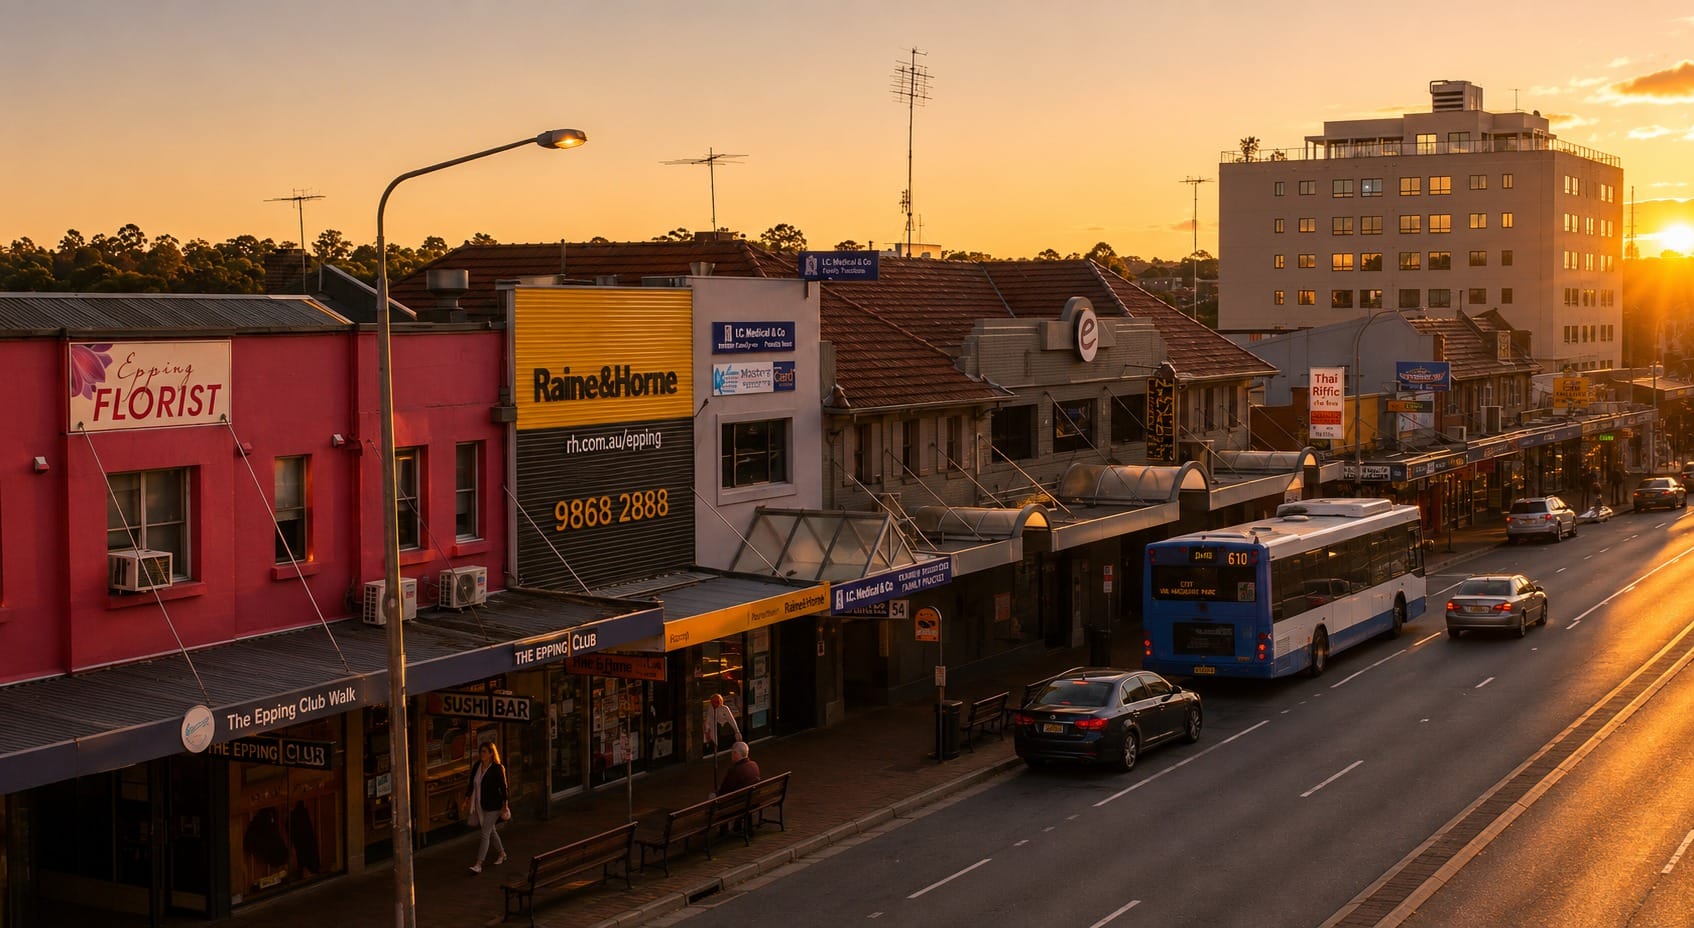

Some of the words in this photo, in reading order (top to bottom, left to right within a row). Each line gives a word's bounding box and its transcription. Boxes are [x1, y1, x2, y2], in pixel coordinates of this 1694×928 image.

[777, 327, 786, 337] Co
[1081, 318, 1097, 350] e
[117, 351, 194, 403] Epping
[533, 364, 678, 403] Raine&Horne
[1314, 373, 1338, 384] Thai
[93, 383, 222, 422] FLORIST
[566, 428, 662, 454] rh.com.au/epping
[554, 495, 612, 532] 9868
[618, 488, 669, 523] 2888
[1228, 552, 1248, 565] 610
[857, 583, 880, 599] Medical
[885, 580, 894, 592] Co
[892, 602, 905, 617] 54
[515, 649, 534, 665] THE
[536, 640, 568, 661] EPPING
[572, 633, 597, 650] CLUB
[227, 713, 251, 730] The
[254, 703, 296, 726] Epping
[299, 695, 326, 713] Club
[329, 687, 356, 706] Walk
[443, 695, 489, 715] SUSHI
[494, 698, 528, 718] BAR
[233, 742, 278, 760] EPPING
